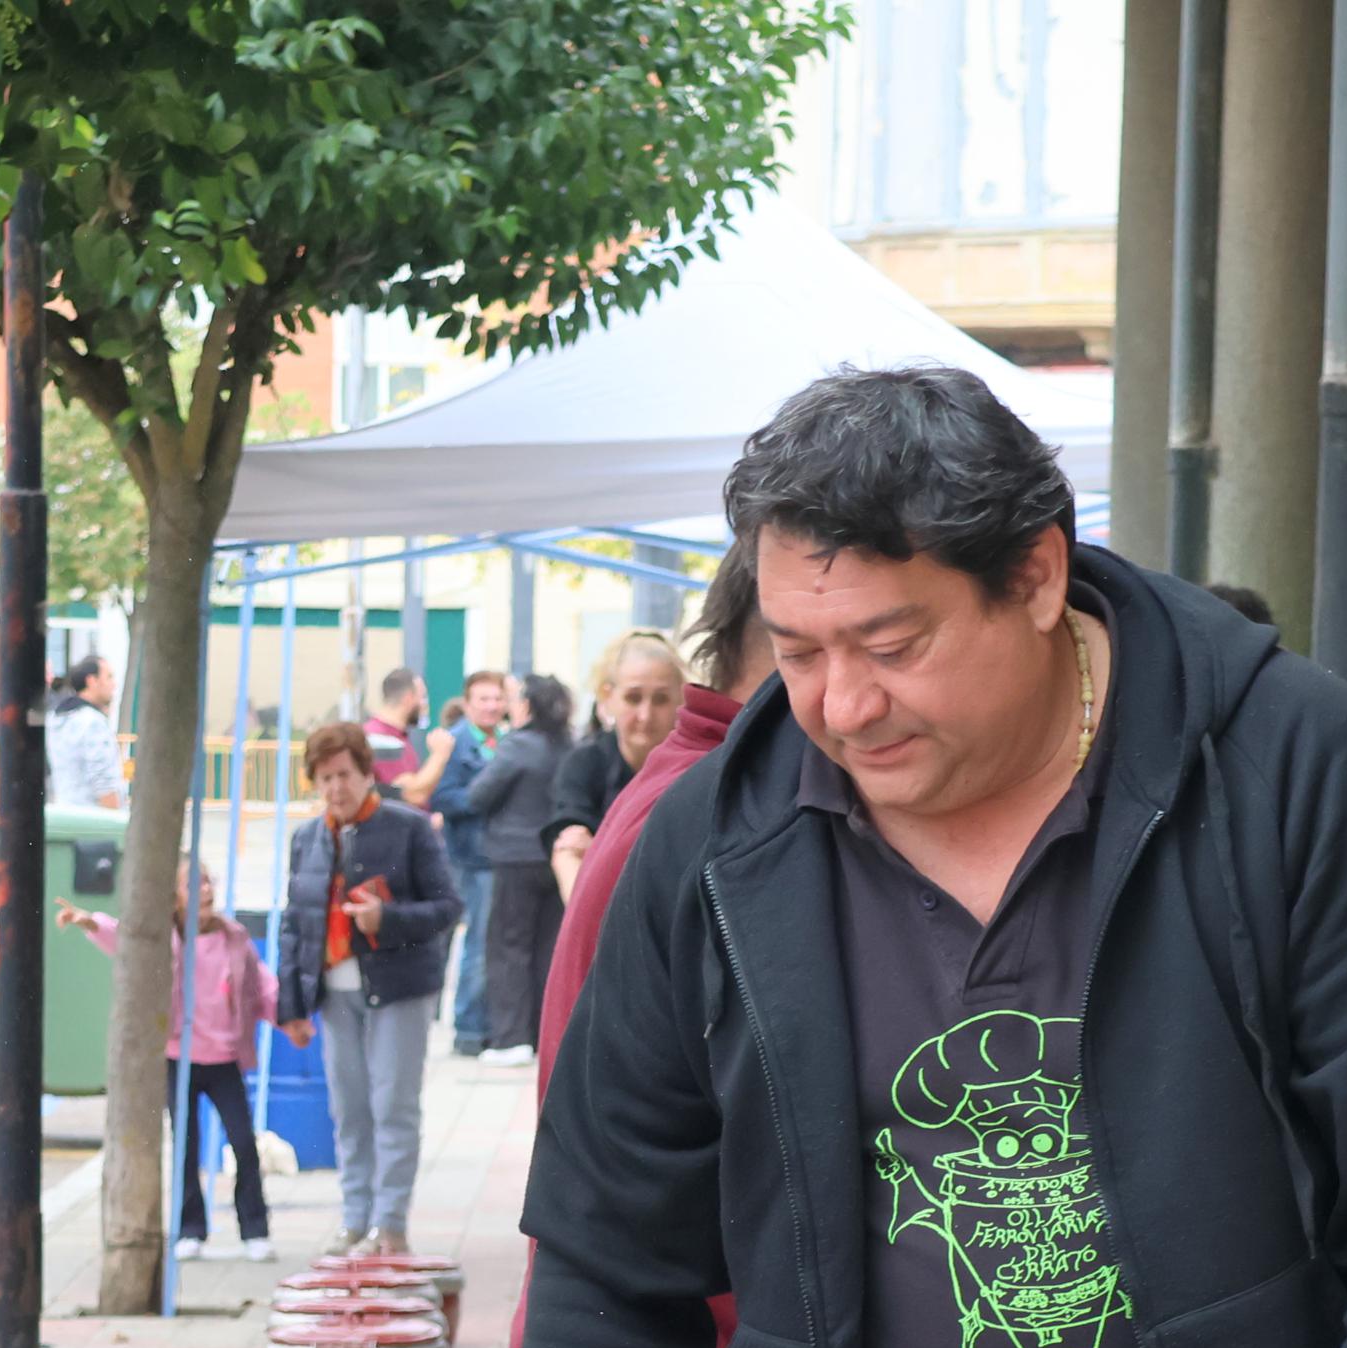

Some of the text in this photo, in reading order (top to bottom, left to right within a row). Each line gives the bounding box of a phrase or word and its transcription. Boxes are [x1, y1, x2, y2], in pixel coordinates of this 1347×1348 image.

[978, 1166, 1089, 1191] ATIZADORES
[1007, 1203, 1076, 1228] OLLAS
[996, 1244, 1097, 1283] CERRATO
[1023, 1242, 1065, 1266] DEL
